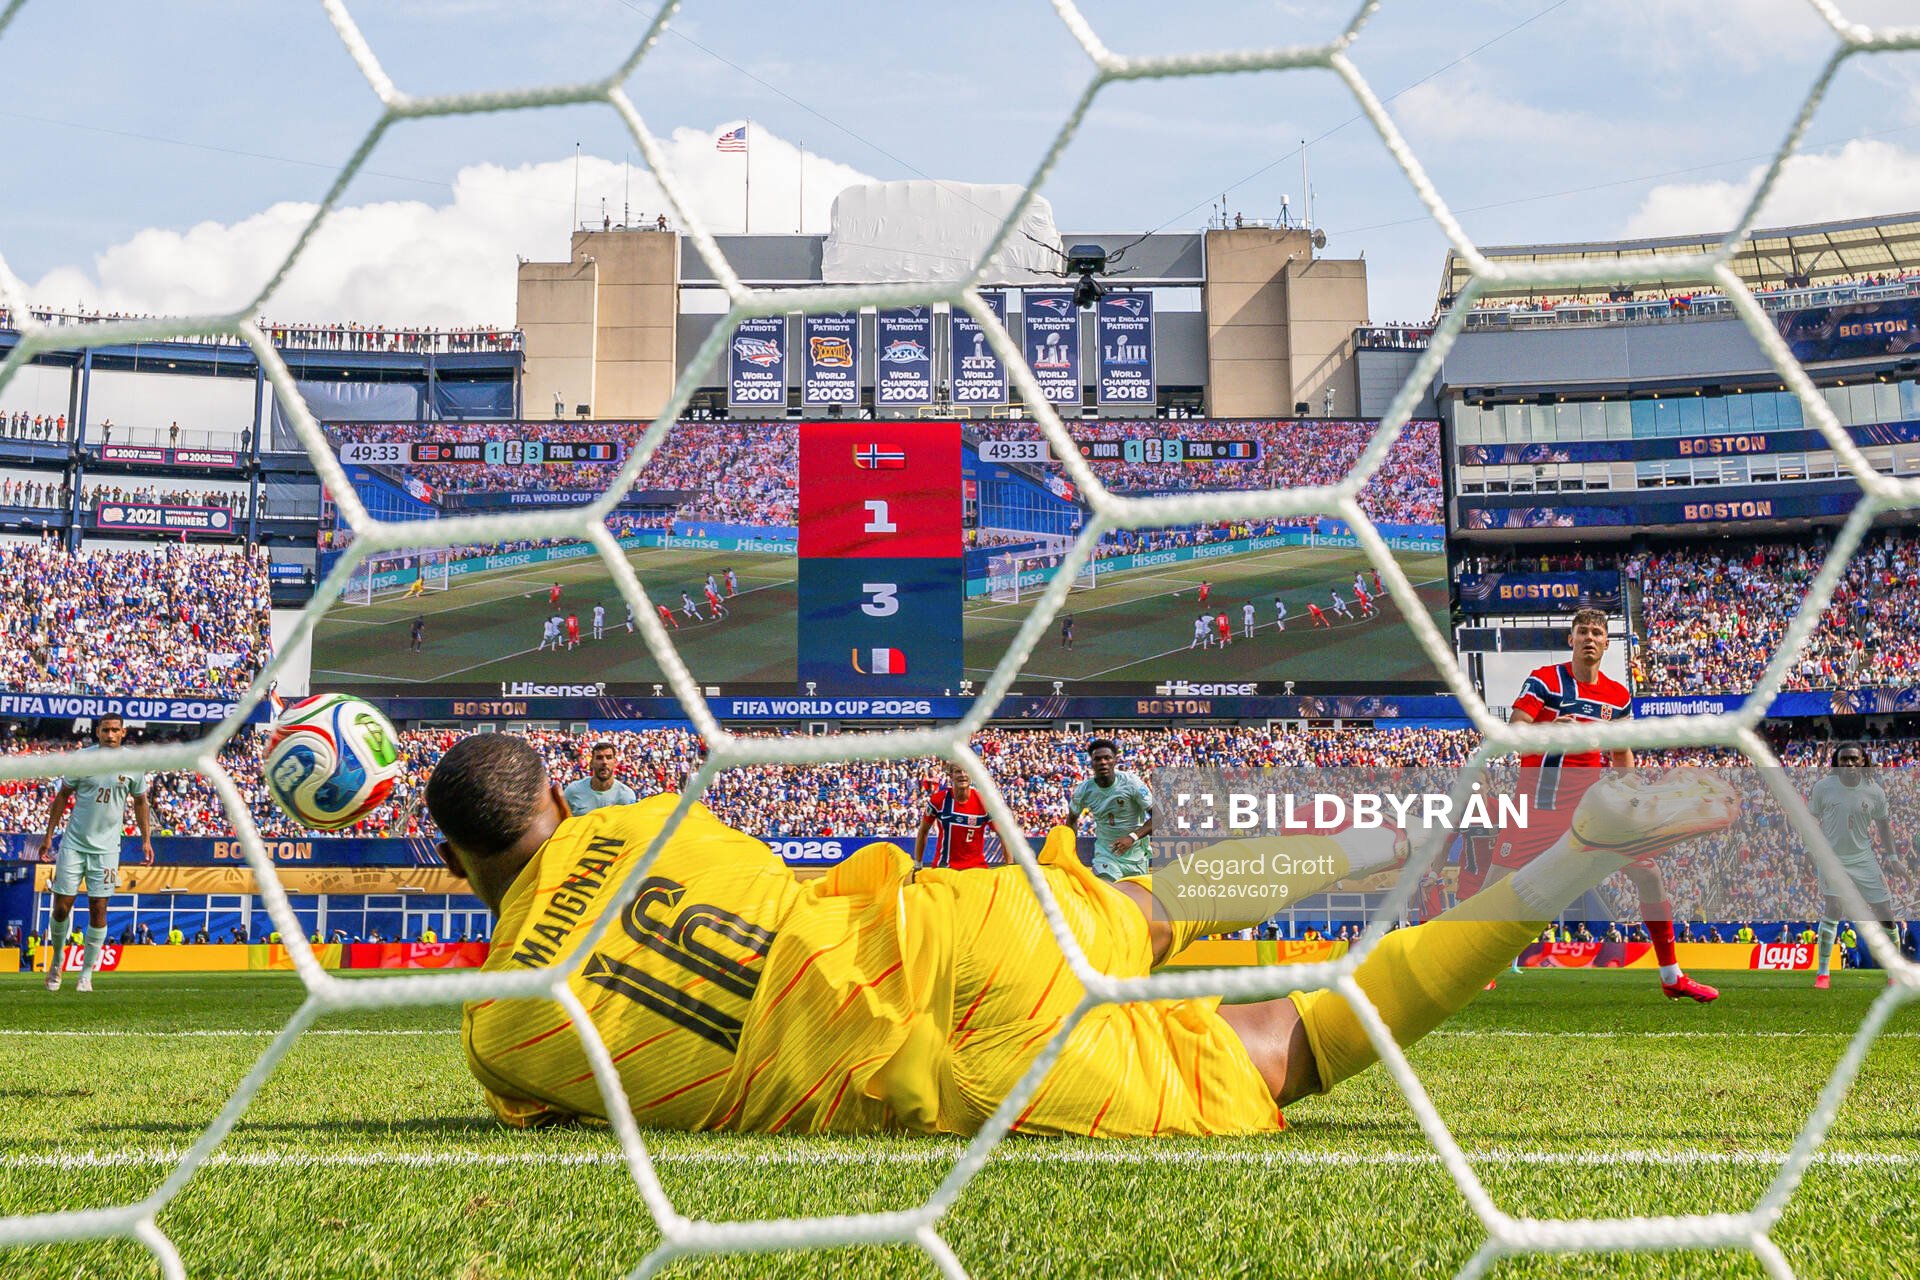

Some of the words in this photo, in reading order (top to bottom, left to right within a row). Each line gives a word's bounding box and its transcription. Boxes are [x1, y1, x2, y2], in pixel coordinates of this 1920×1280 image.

[740, 324, 777, 332] PATRIOTS
[813, 324, 850, 332] PATRIOTS
[1839, 319, 1908, 338] BOSTON
[961, 360, 996, 369] XLIX
[742, 371, 774, 380] WORLD
[815, 371, 847, 380] WORLD
[889, 371, 921, 379] WORLD
[963, 370, 994, 379] WORLD
[1037, 370, 1069, 378] WORLD
[1110, 370, 1142, 378] WORLD
[733, 380, 782, 388] CHAMPIONS
[807, 380, 856, 388] CHAMPIONS
[880, 379, 929, 387] CHAMPIONS
[954, 379, 1003, 387] CHAMPIONS
[1036, 379, 1077, 387] HAMPIONS
[1102, 378, 1151, 386] CHAMPIONS
[735, 388, 780, 401] 2001
[807, 388, 855, 401] 2003
[881, 388, 929, 400] 2004
[958, 387, 1001, 400] 2014
[1105, 386, 1148, 399] 2018
[454, 445, 480, 459] NOR
[550, 445, 573, 459] FRA
[988, 443, 1038, 458] 49:33
[1093, 444, 1119, 457] NOR
[1129, 444, 1138, 457] 1
[1168, 444, 1178, 457] 3
[1189, 444, 1213, 457] FRA
[1679, 435, 1766, 455] BOSTON
[118, 449, 140, 458] 2007
[350, 445, 400, 461] 49:33
[490, 446, 498, 459] 1
[529, 446, 538, 459] 3
[511, 494, 532, 503] FIFA
[533, 493, 570, 503] WORLD
[571, 493, 592, 502] CUP
[126, 508, 161, 524] 2021
[864, 500, 897, 533] 1
[1684, 500, 1772, 520] BOSTON
[165, 515, 209, 527] WINNERS
[657, 534, 720, 549] Hisense
[1249, 536, 1286, 550] Hisense
[547, 544, 588, 560] Hisense
[1192, 543, 1234, 558] Hisense
[485, 554, 531, 569] Hisense
[1132, 552, 1177, 568] Hisense
[1500, 583, 1579, 599] BOSTON
[860, 583, 900, 617] 3
[511, 682, 598, 697] Hisense
[1165, 680, 1252, 696] Hisense
[0, 695, 45, 715] FIFA
[48, 698, 123, 717] WORLD
[125, 700, 168, 718] CUP
[453, 702, 528, 716] BOSTON
[732, 701, 769, 715] FIFA
[773, 701, 834, 715] WORLD
[835, 701, 870, 715] CUP
[871, 701, 931, 715] 2026
[1137, 700, 1212, 715] BOSTON
[1641, 700, 1724, 715] #FIFAWorldCup
[95, 787, 111, 804] 26
[965, 828, 975, 843] 2
[213, 841, 313, 860] BOTON
[768, 841, 843, 860] 2026
[103, 867, 116, 884] 26
[511, 835, 627, 969] MAIGNAN
[1758, 943, 1808, 970] Lay's
[581, 876, 779, 1055] 16
